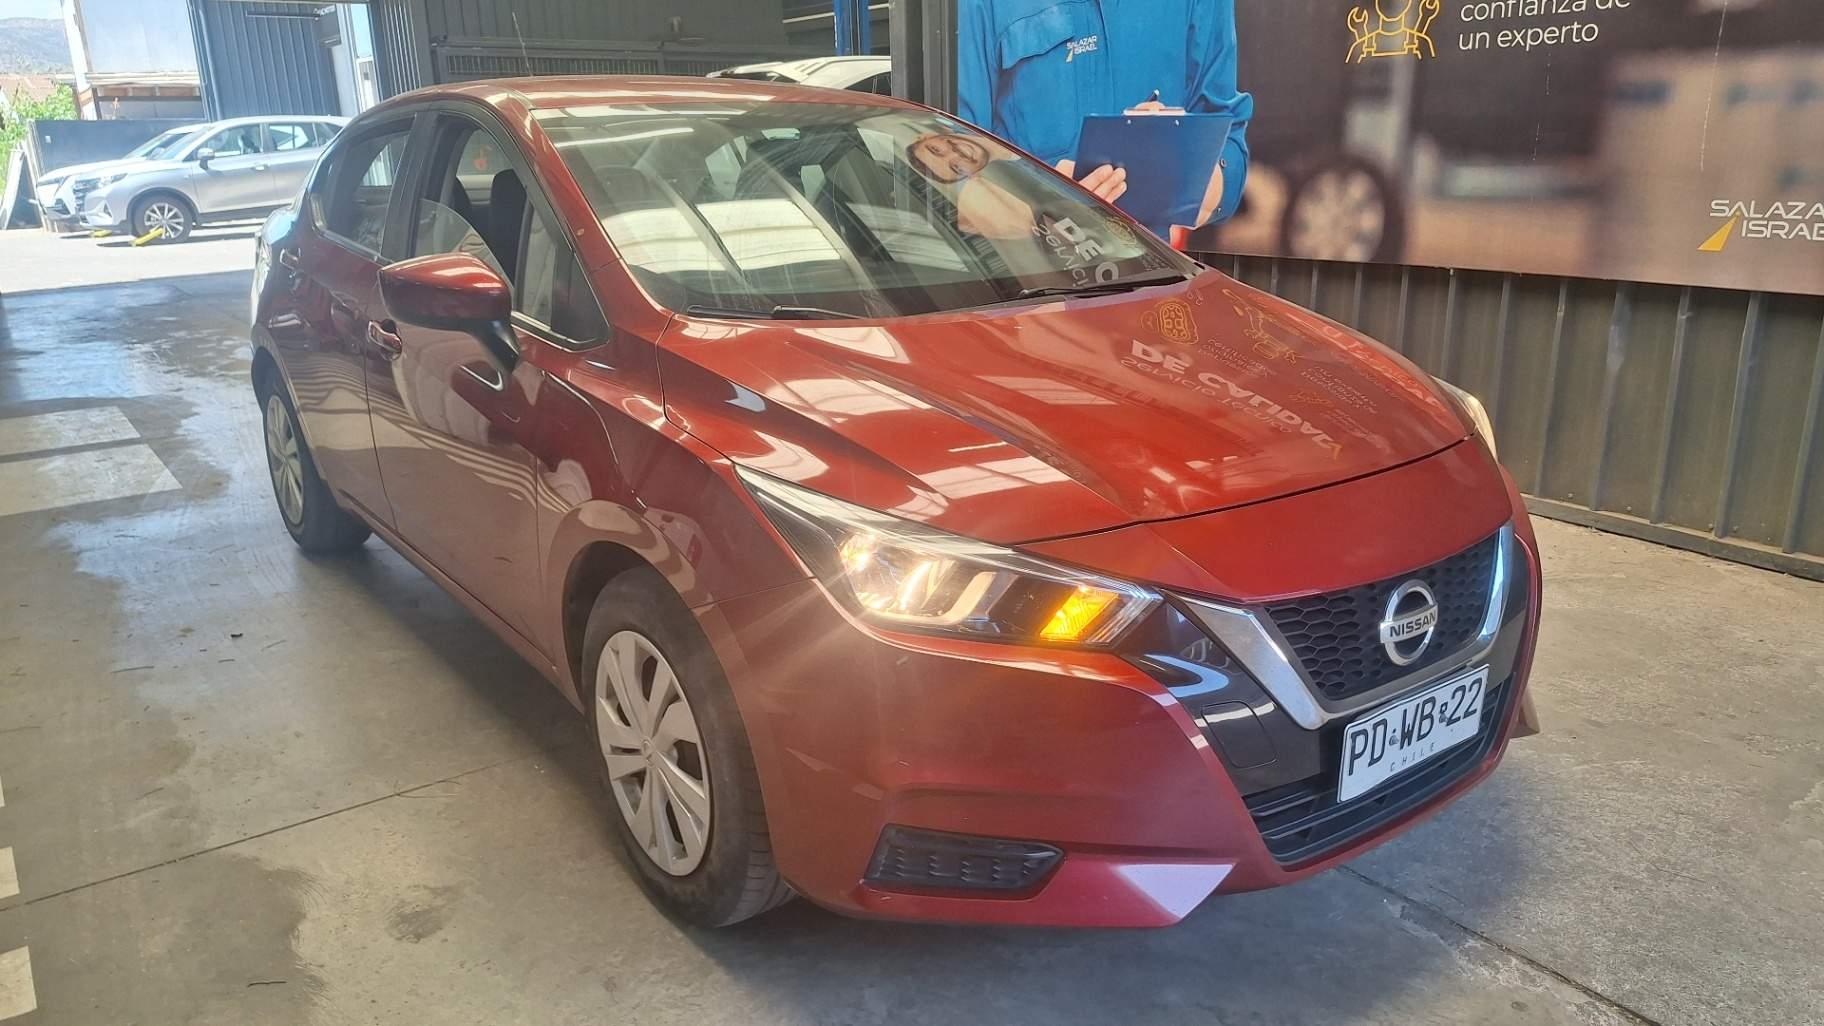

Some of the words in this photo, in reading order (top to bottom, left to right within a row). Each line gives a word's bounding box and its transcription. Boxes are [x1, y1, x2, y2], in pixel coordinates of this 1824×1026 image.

[1460, 0, 1586, 22] confianza
[1458, 31, 1490, 50] un
[1497, 21, 1599, 51] experto
[1390, 612, 1436, 638] NISSAN
[1389, 742, 1436, 773] CHILE
